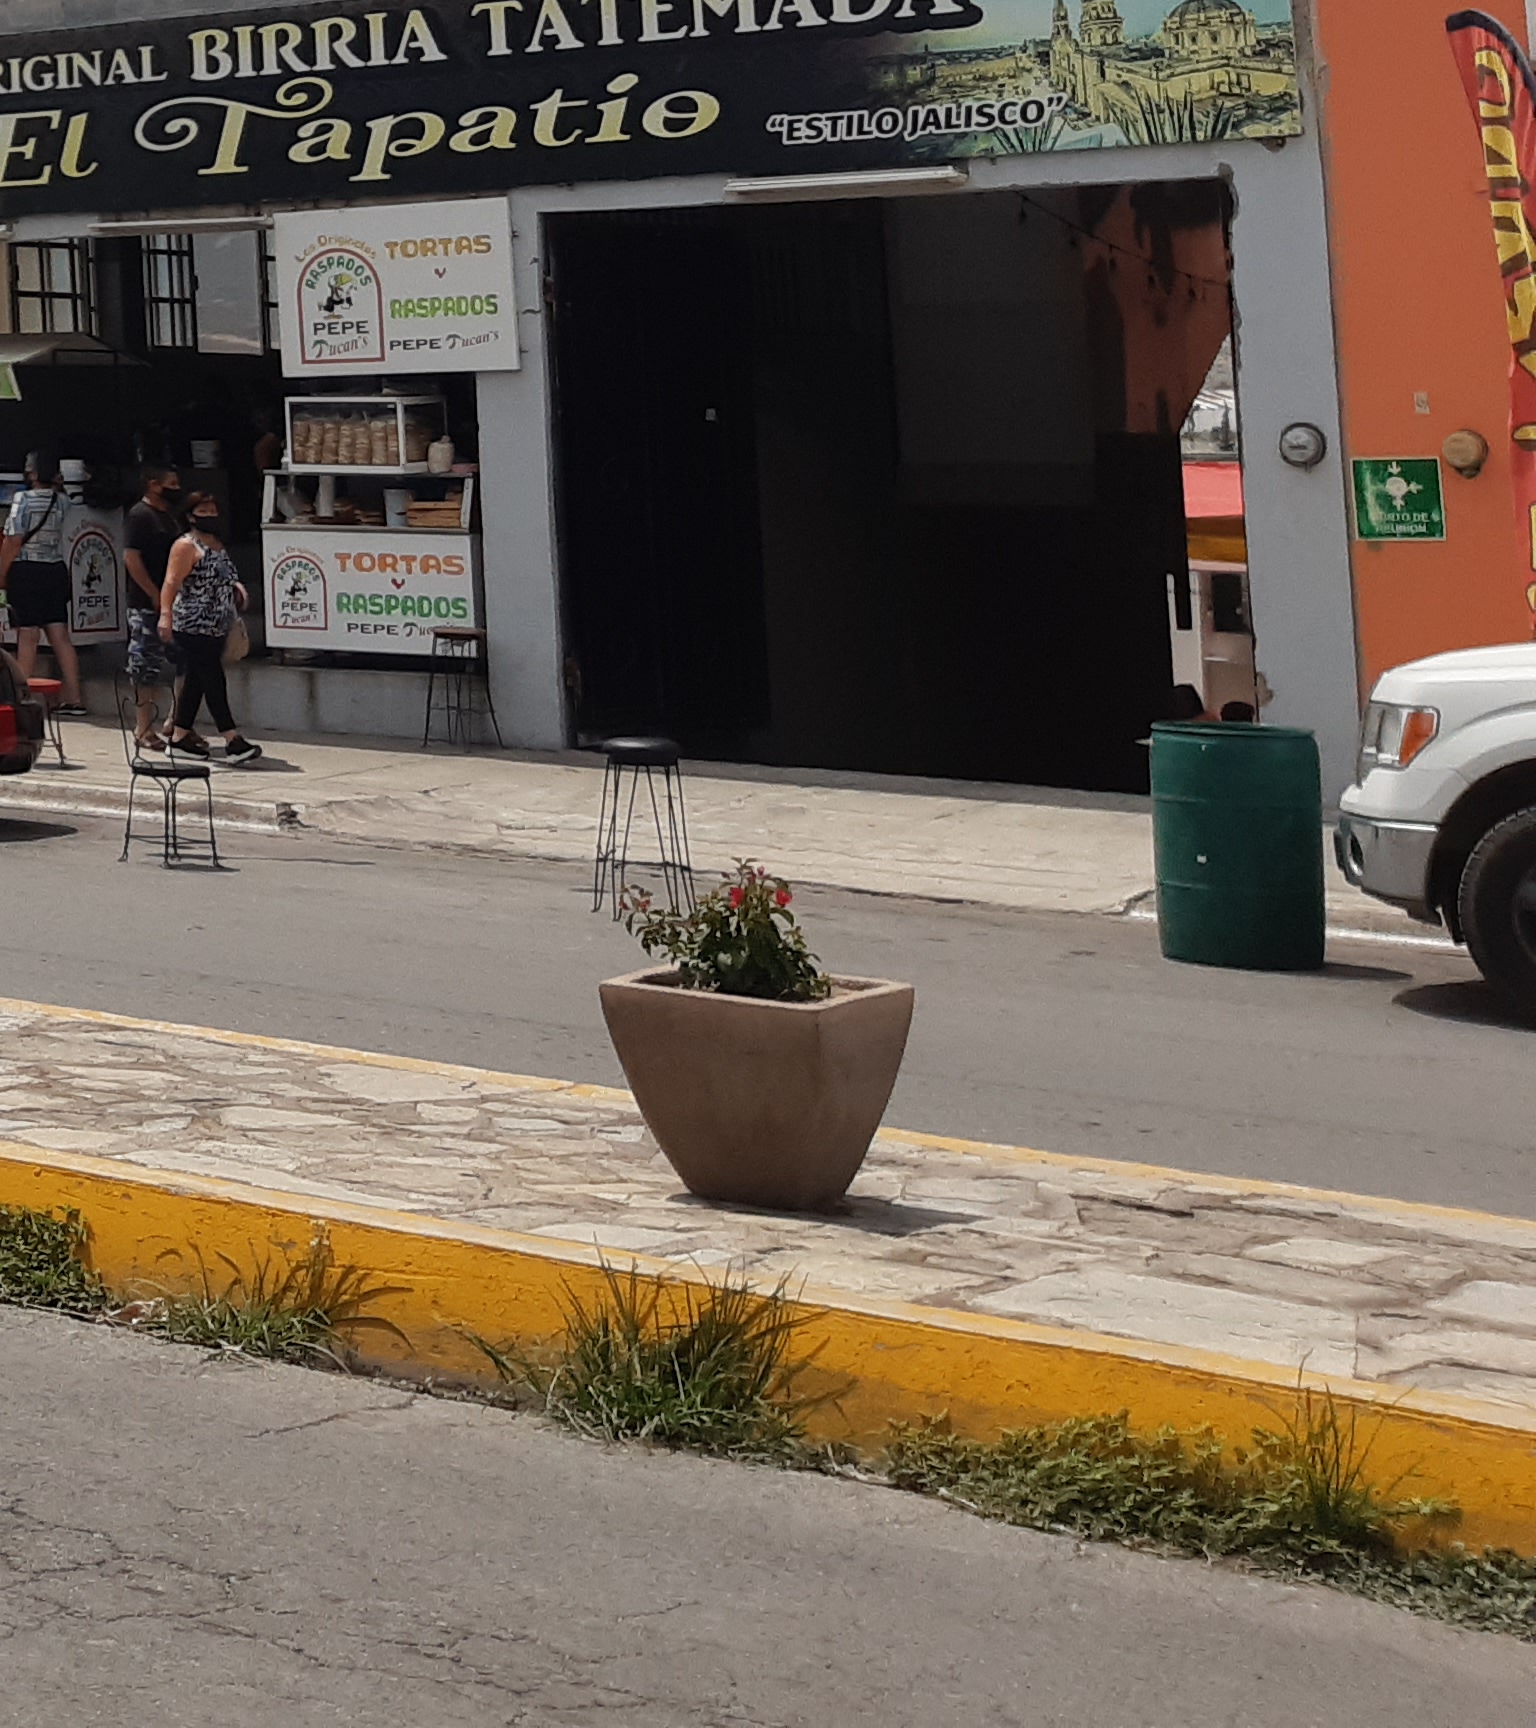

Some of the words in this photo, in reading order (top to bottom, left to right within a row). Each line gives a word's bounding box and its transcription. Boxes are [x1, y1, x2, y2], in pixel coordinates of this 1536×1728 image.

[188, 9, 447, 82] BIRRIA
[384, 234, 492, 260] TORTAS
[304, 255, 373, 290] RASPADOS
[389, 294, 499, 320] RASPADOS
[312, 320, 370, 336] PEPE
[389, 338, 442, 351] PEPE
[334, 552, 466, 576] TORTAS
[79, 595, 111, 608] PEPE
[281, 601, 318, 612] PEPE
[336, 592, 468, 619] RASPADOS
[347, 622, 399, 636] PEPE
